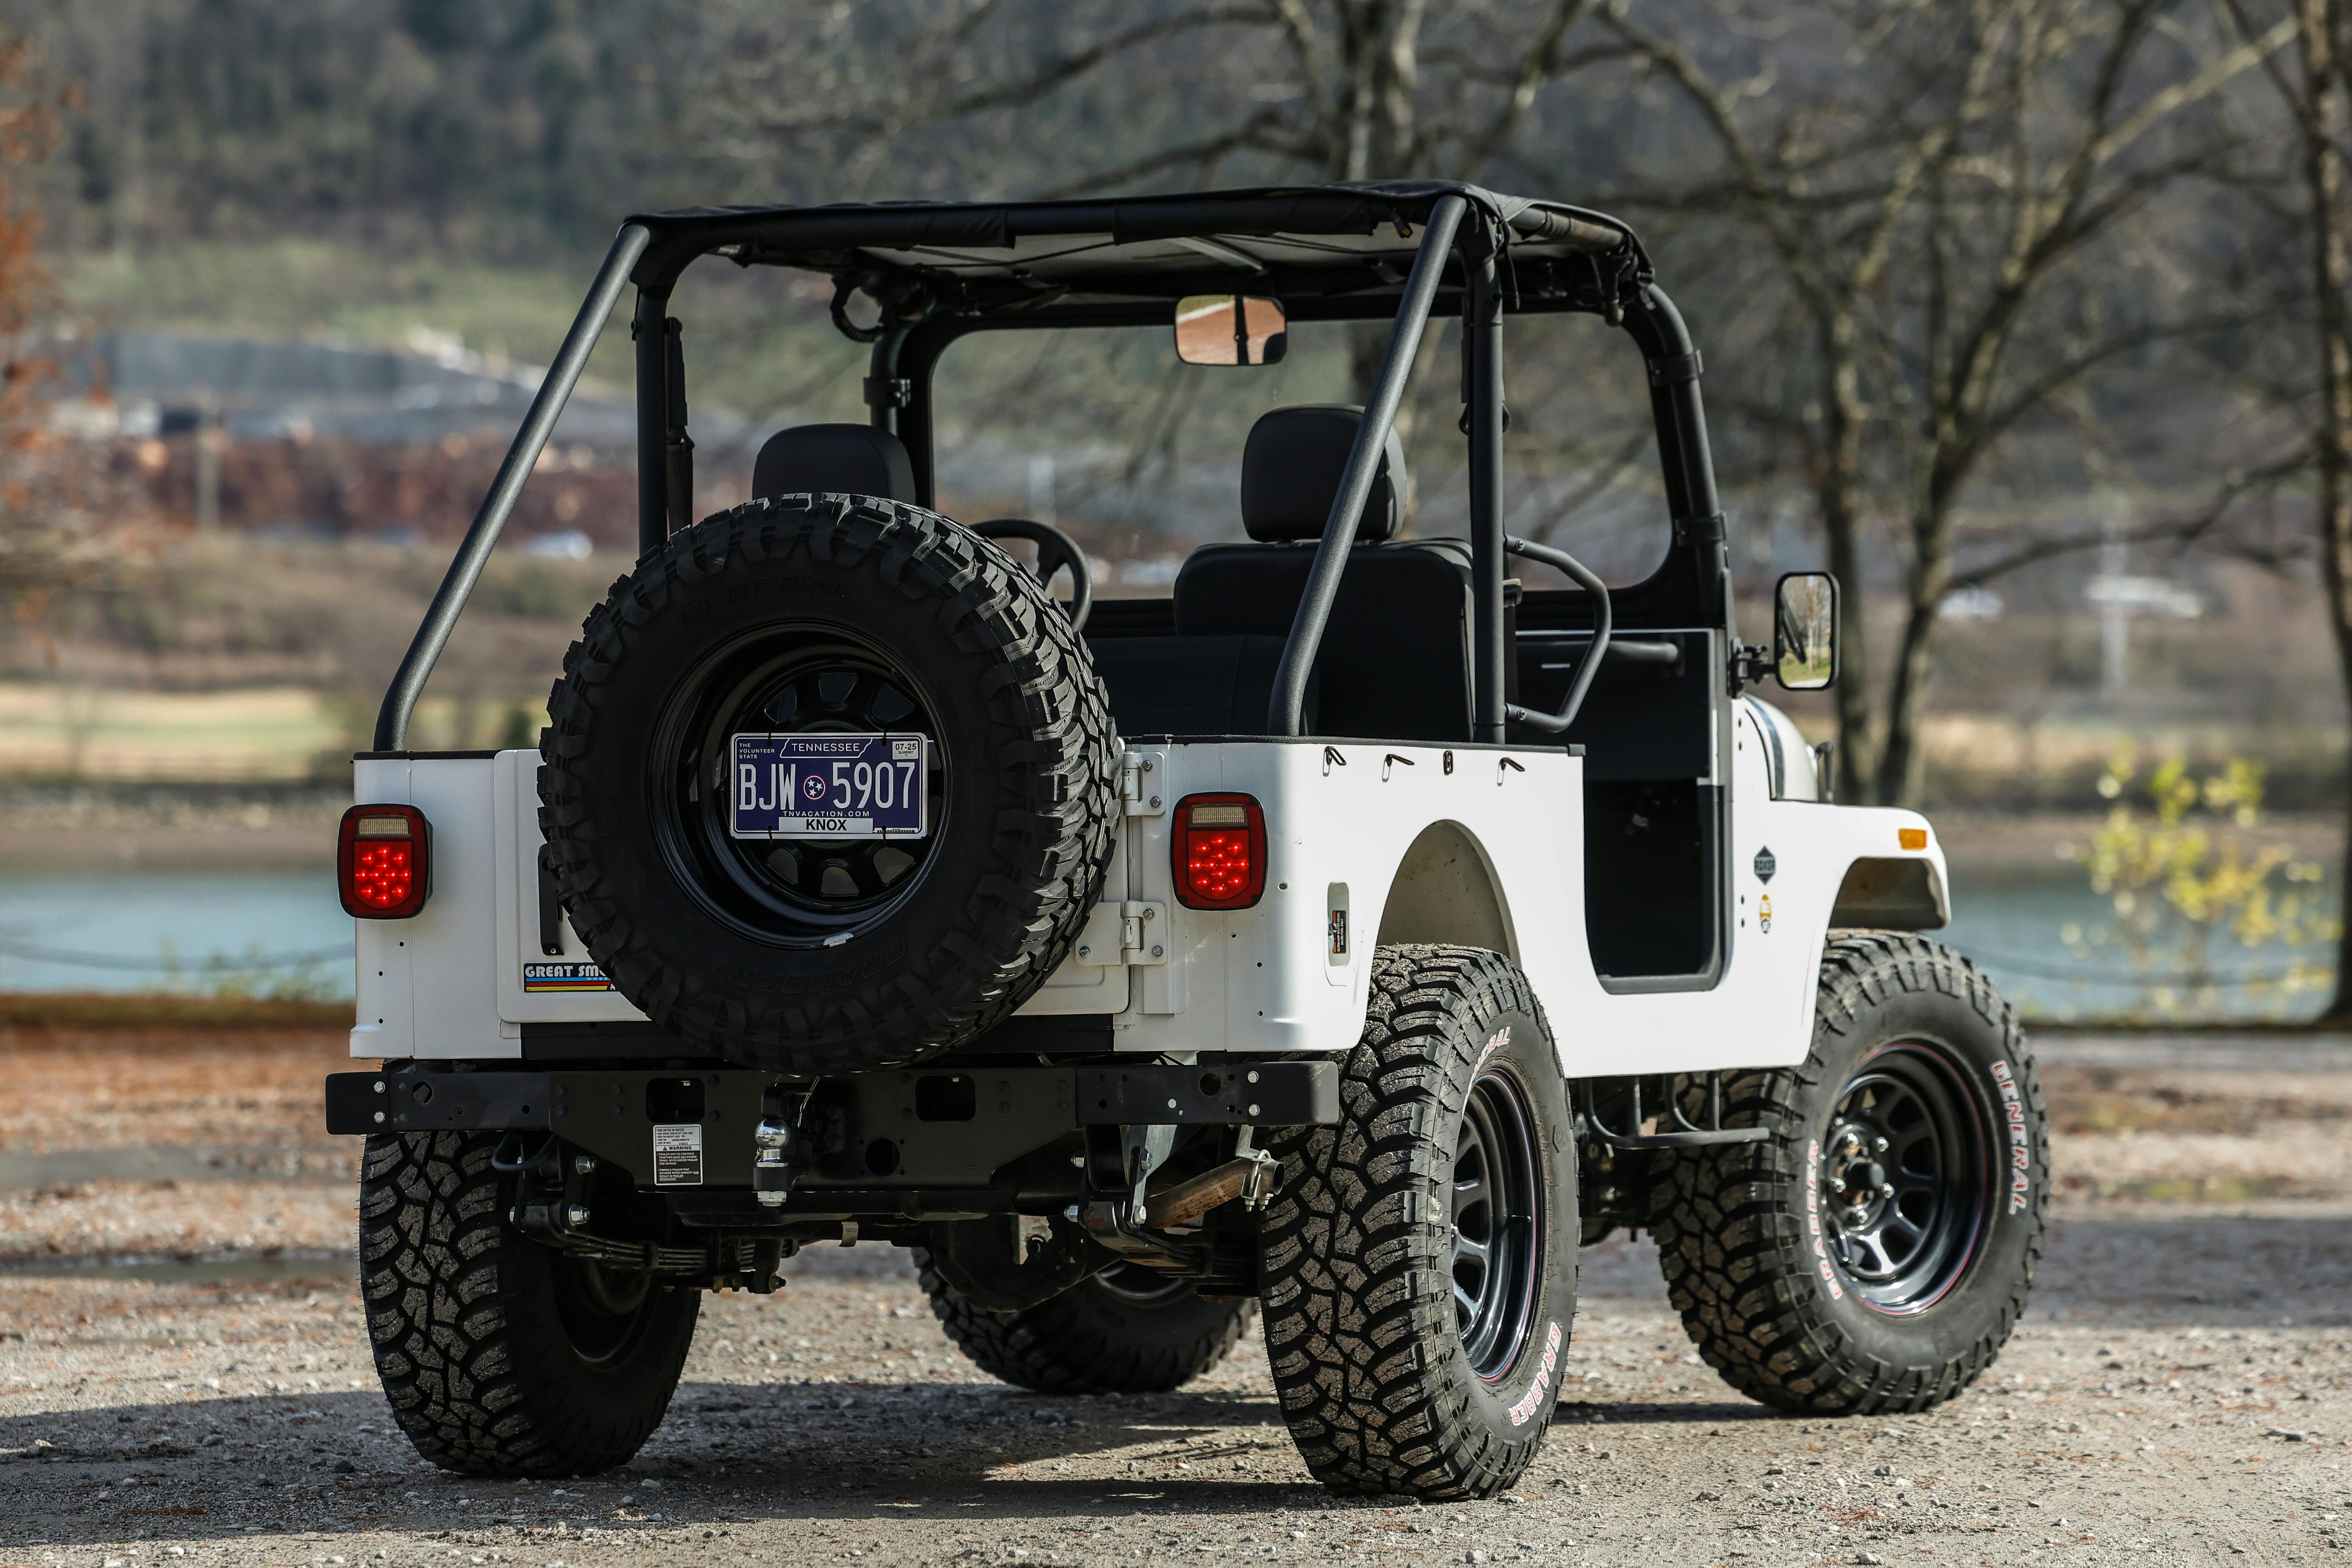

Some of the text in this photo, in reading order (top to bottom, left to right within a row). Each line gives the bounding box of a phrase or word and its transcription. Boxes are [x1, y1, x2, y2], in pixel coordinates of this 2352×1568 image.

[680, 577, 854, 629] GENERAL
[739, 762, 915, 810] BJW 5907
[806, 819, 847, 831] KNOX
[525, 966, 573, 977] GREAT
[729, 938, 906, 993] GRABBER
[1462, 1027, 1510, 1120] NERAL
[1989, 1059, 2028, 1215] GENERAL
[1508, 1322, 1561, 1426] GRABBER
